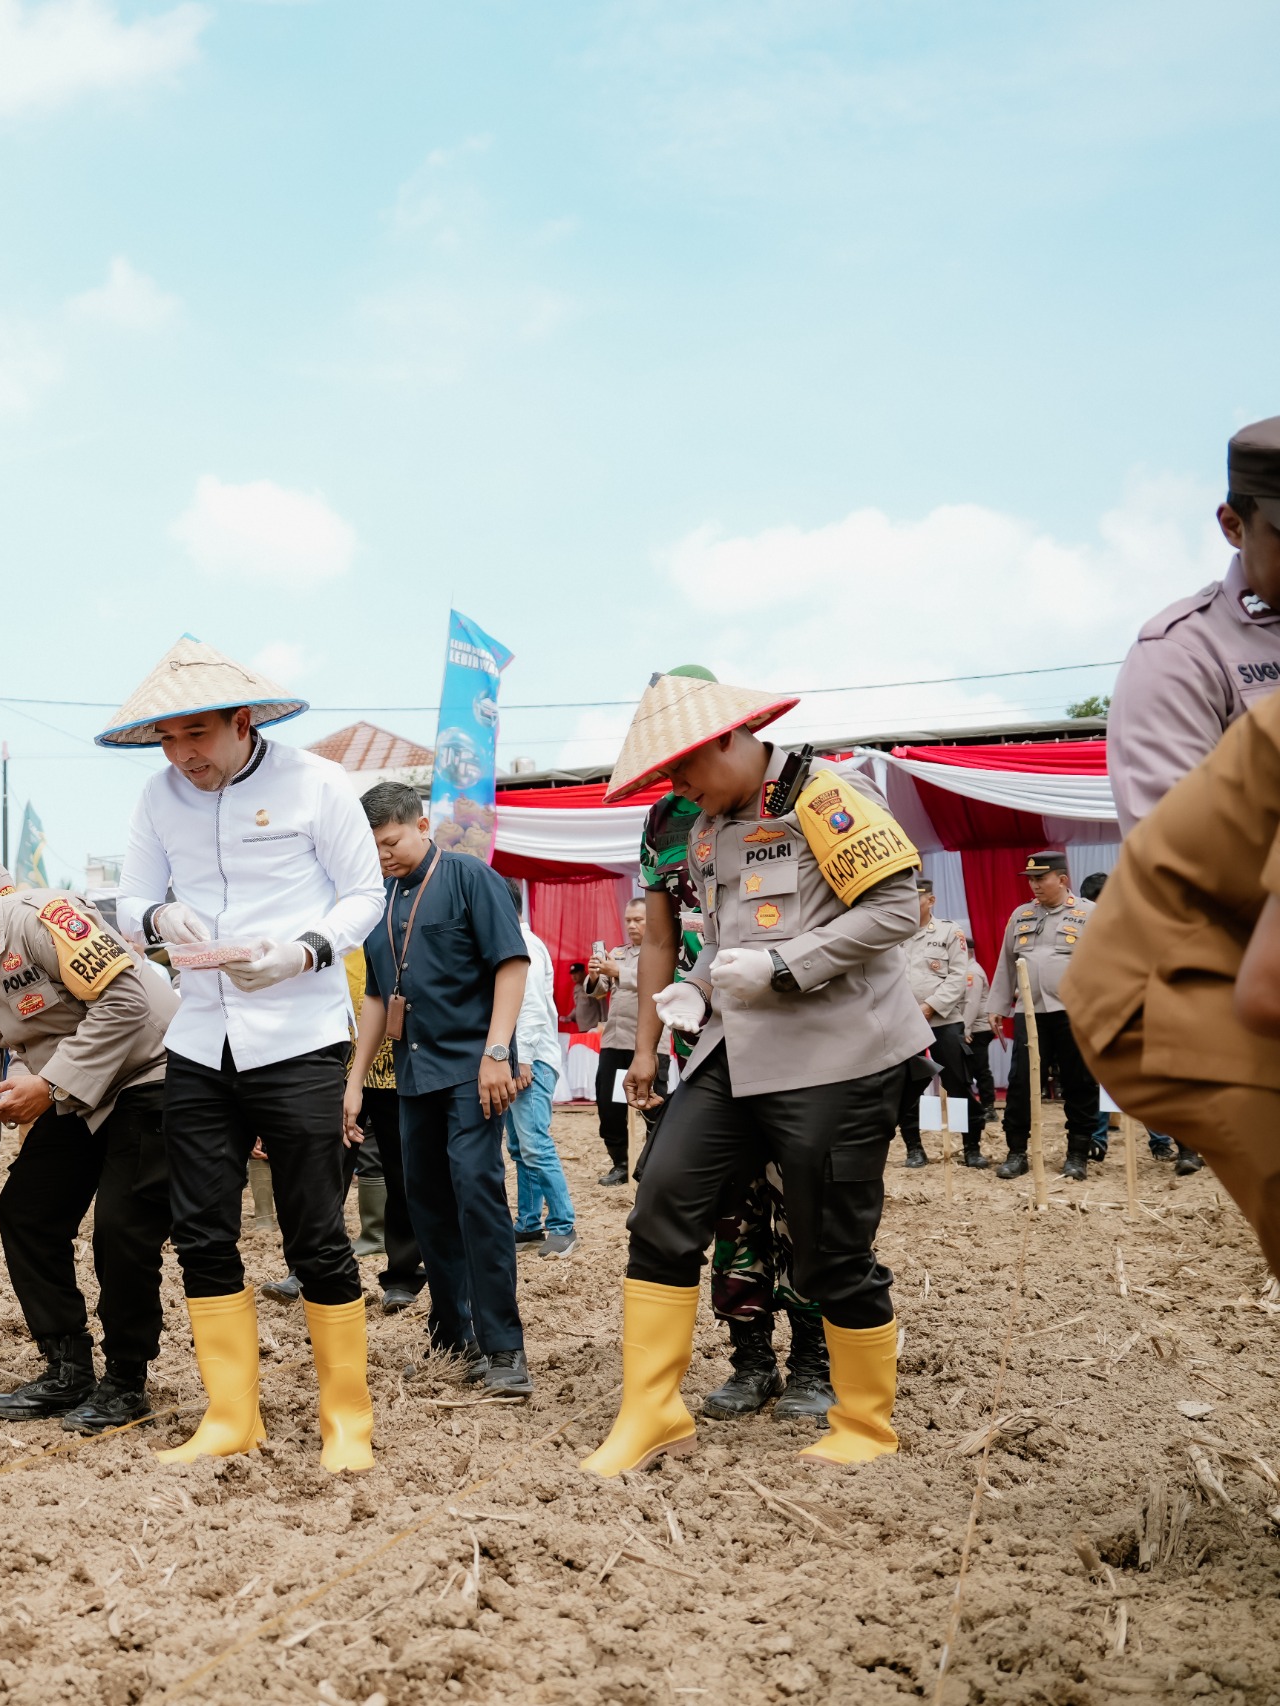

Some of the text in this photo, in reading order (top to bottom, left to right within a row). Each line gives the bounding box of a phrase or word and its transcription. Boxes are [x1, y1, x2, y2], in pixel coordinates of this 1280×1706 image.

[746, 842, 792, 865] POLRI
[824, 828, 908, 891] KAOPSRESTA
[2, 965, 41, 993] POLRI
